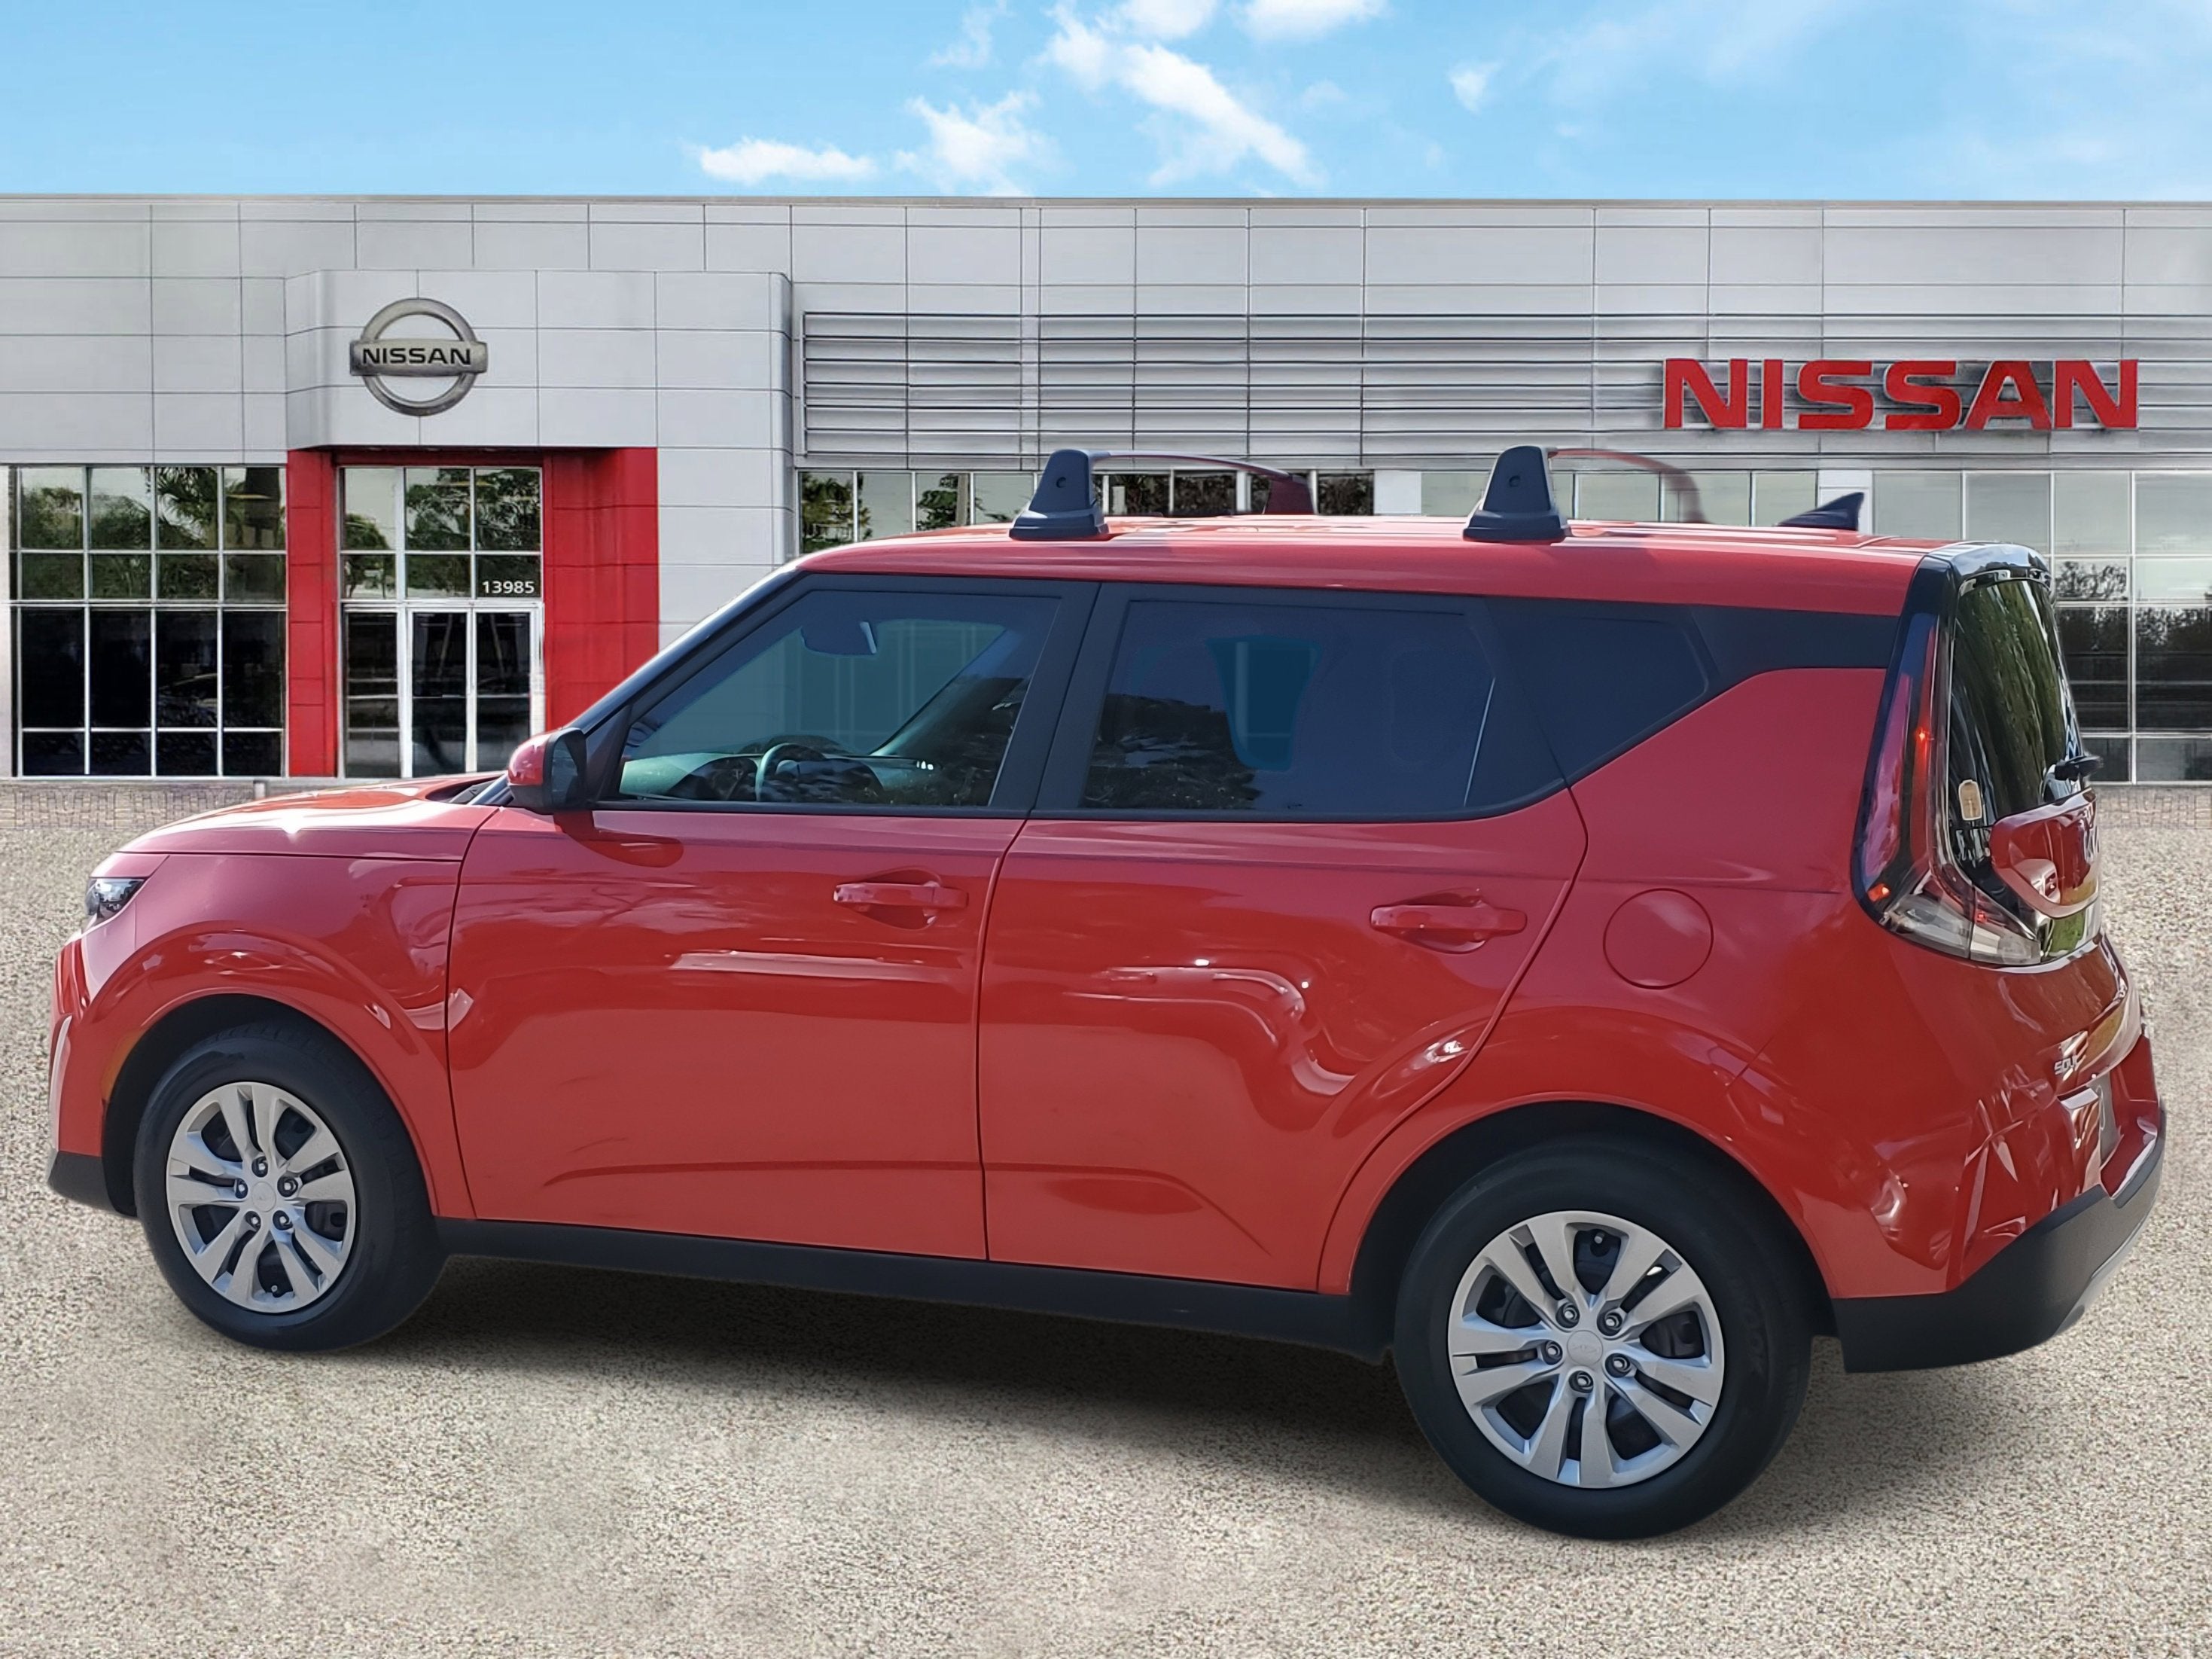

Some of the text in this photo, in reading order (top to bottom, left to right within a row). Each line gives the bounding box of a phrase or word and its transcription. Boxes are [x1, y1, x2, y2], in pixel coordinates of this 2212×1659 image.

[362, 348, 471, 364] NISSAN
[1663, 358, 2139, 431] NISSAN
[483, 580, 535, 593] 13985
